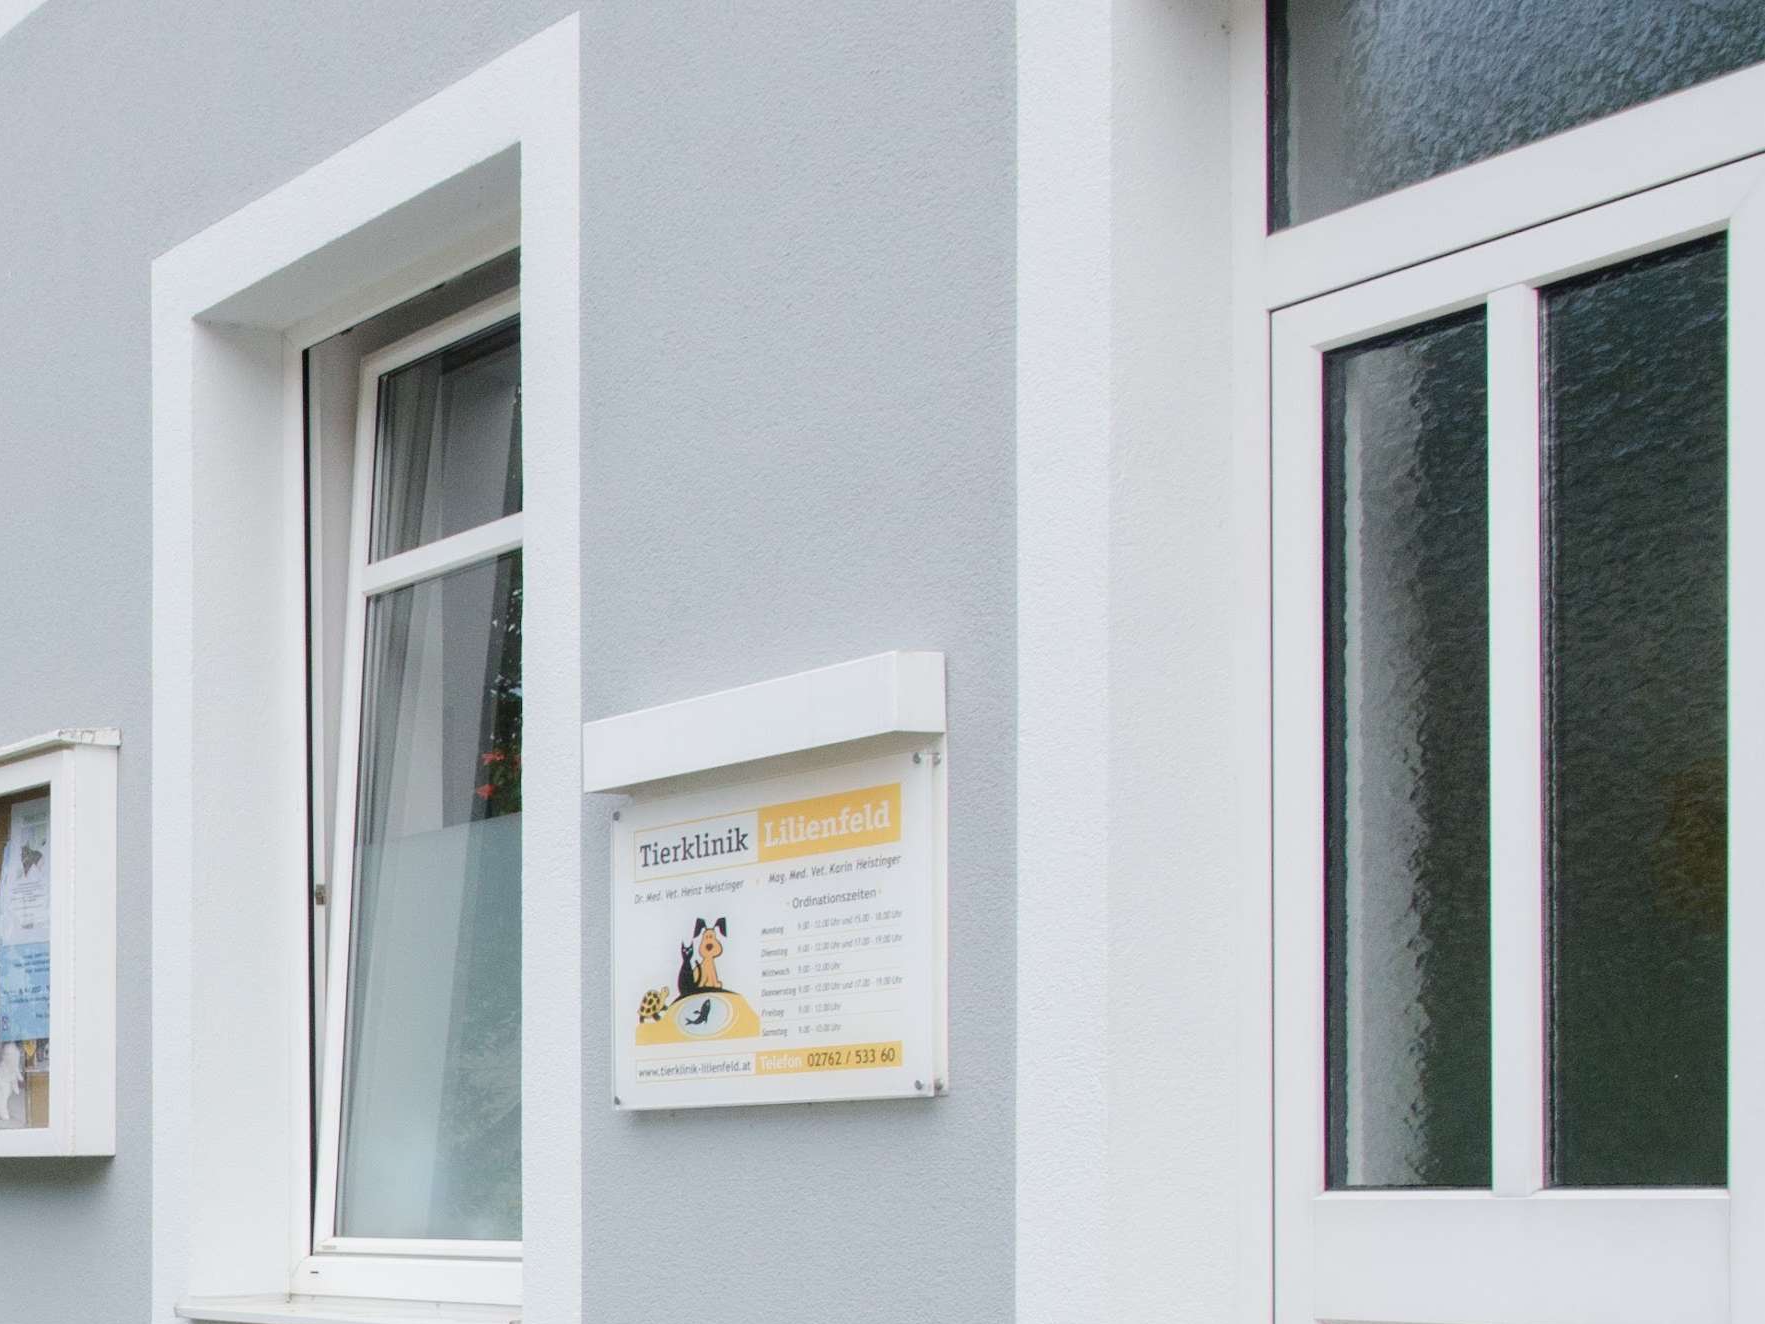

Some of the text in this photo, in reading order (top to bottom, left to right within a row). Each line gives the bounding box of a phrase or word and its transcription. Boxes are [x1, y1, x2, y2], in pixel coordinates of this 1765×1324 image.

[640, 799, 891, 867] Tierklinik Lilienfeld
[768, 854, 901, 885] Mag. Med. Vet. Karin Heistinger
[705, 879, 744, 895] Heistinger
[792, 887, 877, 909] Ordinationszeiten
[639, 1059, 751, 1078] www.tierklinik-lilienfeld.at
[760, 1055, 802, 1071] Telefon
[808, 1050, 841, 1067] 02762
[855, 1048, 875, 1064] 533
[880, 1047, 895, 1062] 60
